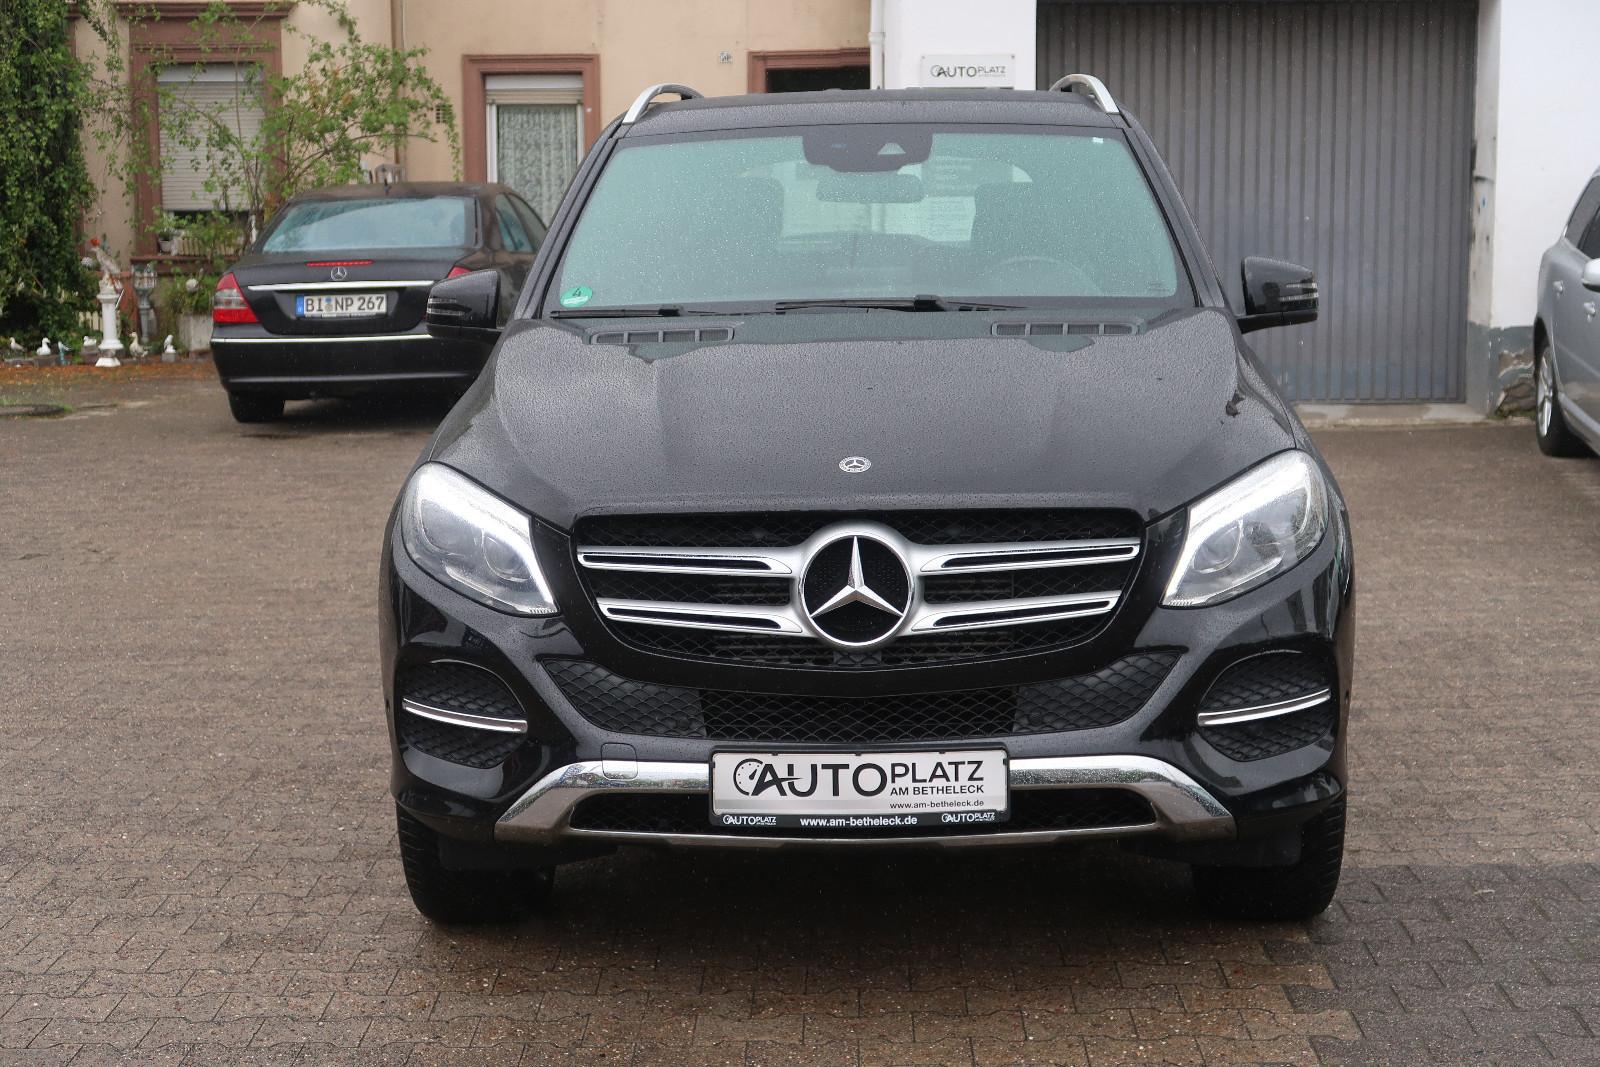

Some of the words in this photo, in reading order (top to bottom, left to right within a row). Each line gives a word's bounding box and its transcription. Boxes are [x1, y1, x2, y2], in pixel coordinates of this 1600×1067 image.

[572, 287, 581, 297] 4
[305, 298, 323, 312] BI
[335, 297, 353, 311] NP
[358, 296, 384, 311] 267
[890, 787, 909, 796] AM
[913, 784, 984, 796] BETHELECK
[890, 799, 985, 809] www.am-betheleck.de
[800, 815, 918, 827] www.am-betheleck.de
